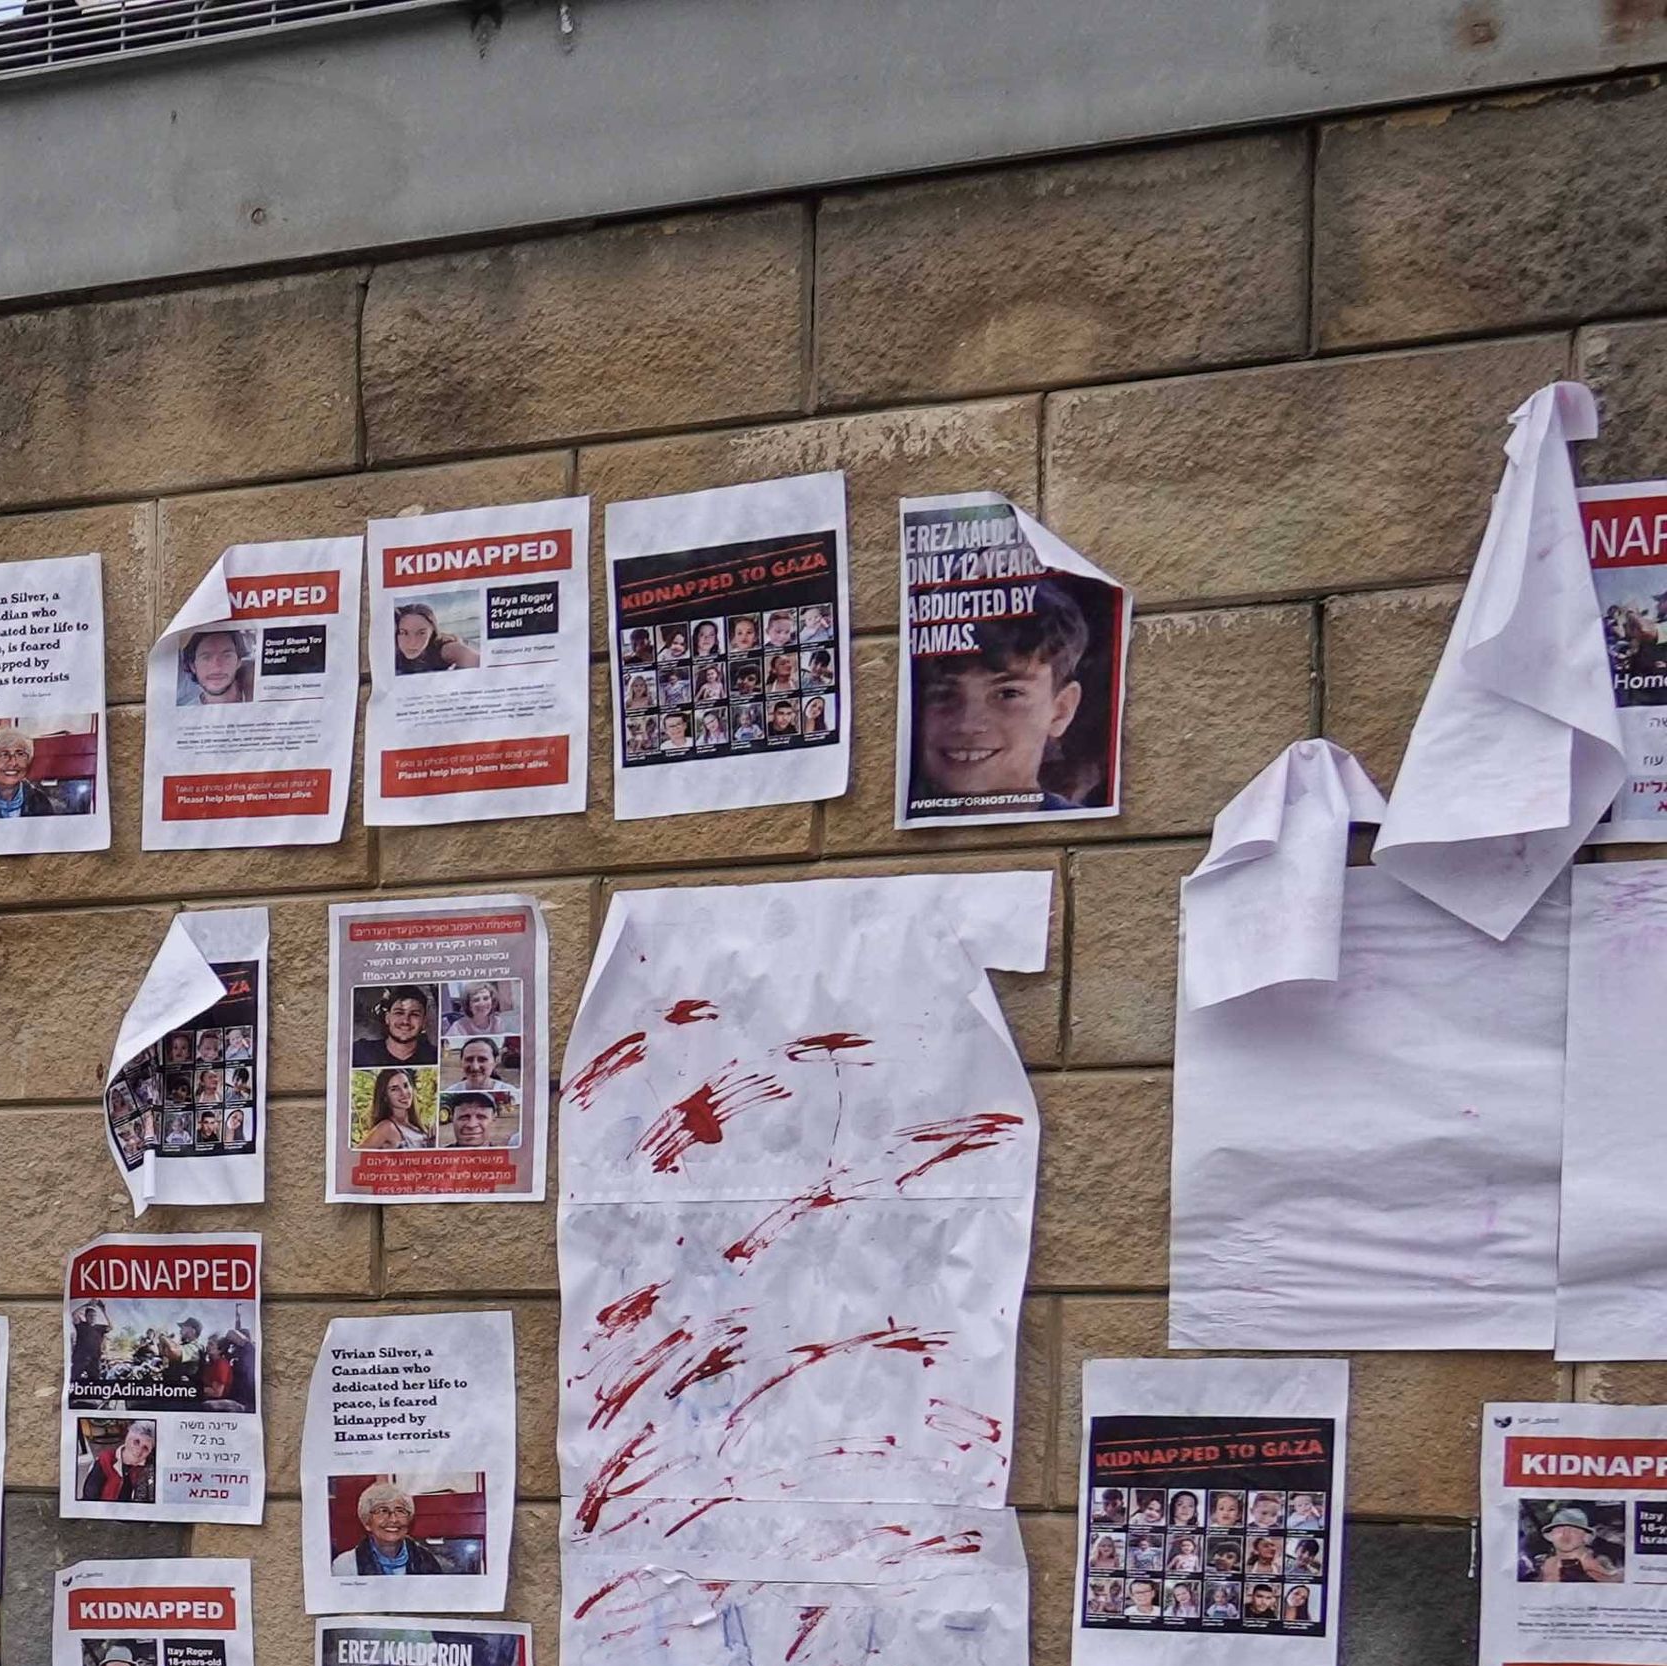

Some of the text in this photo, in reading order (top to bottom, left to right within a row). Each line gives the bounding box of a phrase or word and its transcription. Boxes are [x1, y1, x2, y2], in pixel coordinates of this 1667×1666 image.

[906, 515, 1028, 553] EREZ KALDE
[395, 540, 557, 574] KIDNAPPED
[959, 552, 981, 581] 12
[621, 552, 828, 608] KIDNAPPED TO GAZA
[908, 586, 1036, 618] ABDUCTED BY
[491, 618, 522, 629] Israeli
[910, 793, 1044, 808] #VOICESFORHOSTAGES
[80, 1260, 251, 1291] KIDNAPPED
[192, 1435, 226, 1445] בת 72
[1096, 1439, 1324, 1466] KIDNAPPED TO GAZA
[80, 1601, 223, 1619] KIDNAPPED
[338, 1639, 380, 1664] EREZ
